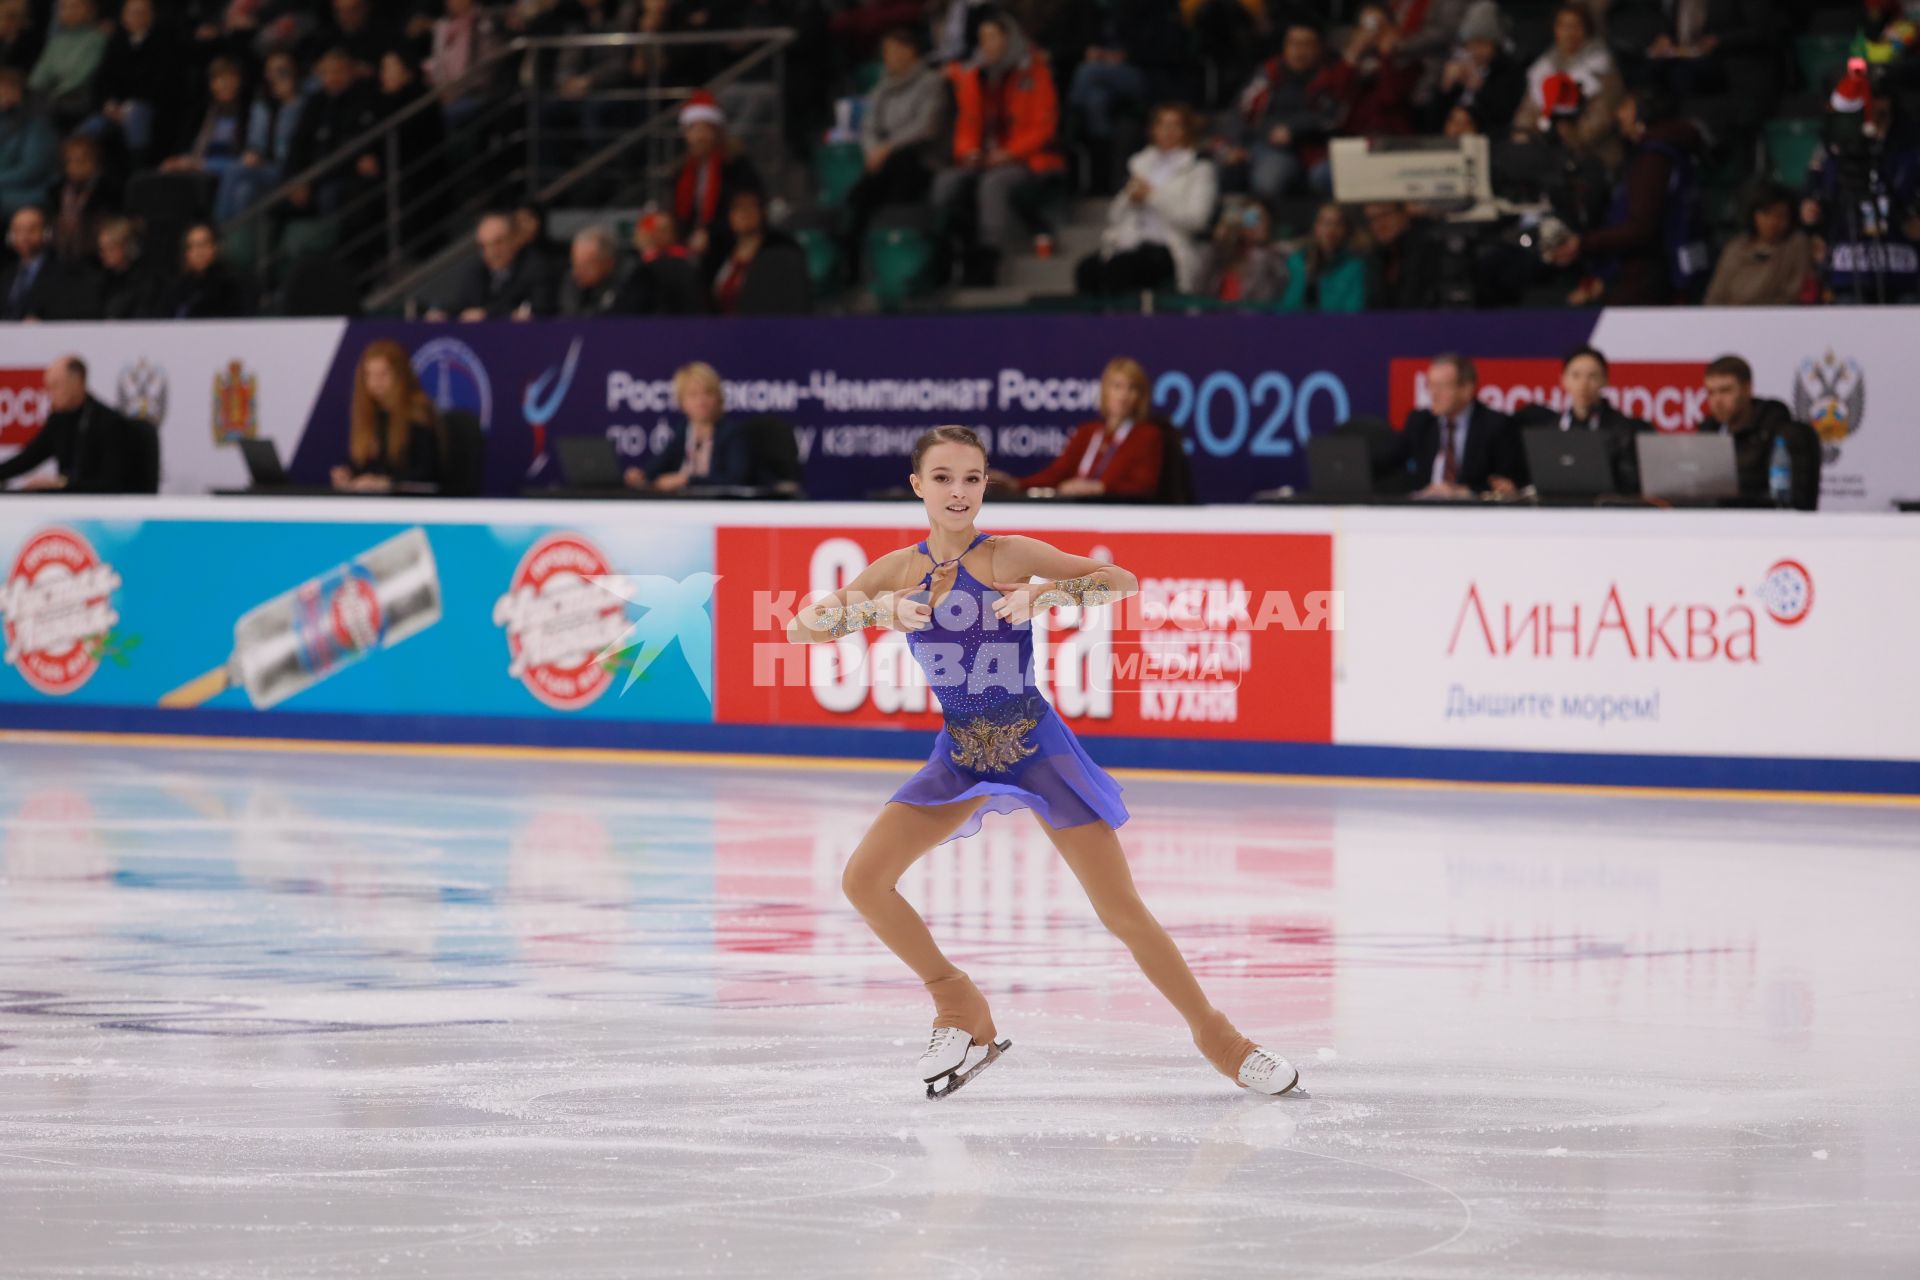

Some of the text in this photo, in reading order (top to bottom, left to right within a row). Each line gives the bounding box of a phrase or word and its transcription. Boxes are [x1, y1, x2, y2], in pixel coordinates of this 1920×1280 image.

[998, 369, 1104, 412] Росси
[1153, 370, 1350, 457] 2020
[1140, 681, 1238, 722] КУХНЯ
[1446, 685, 1553, 719] Дышите
